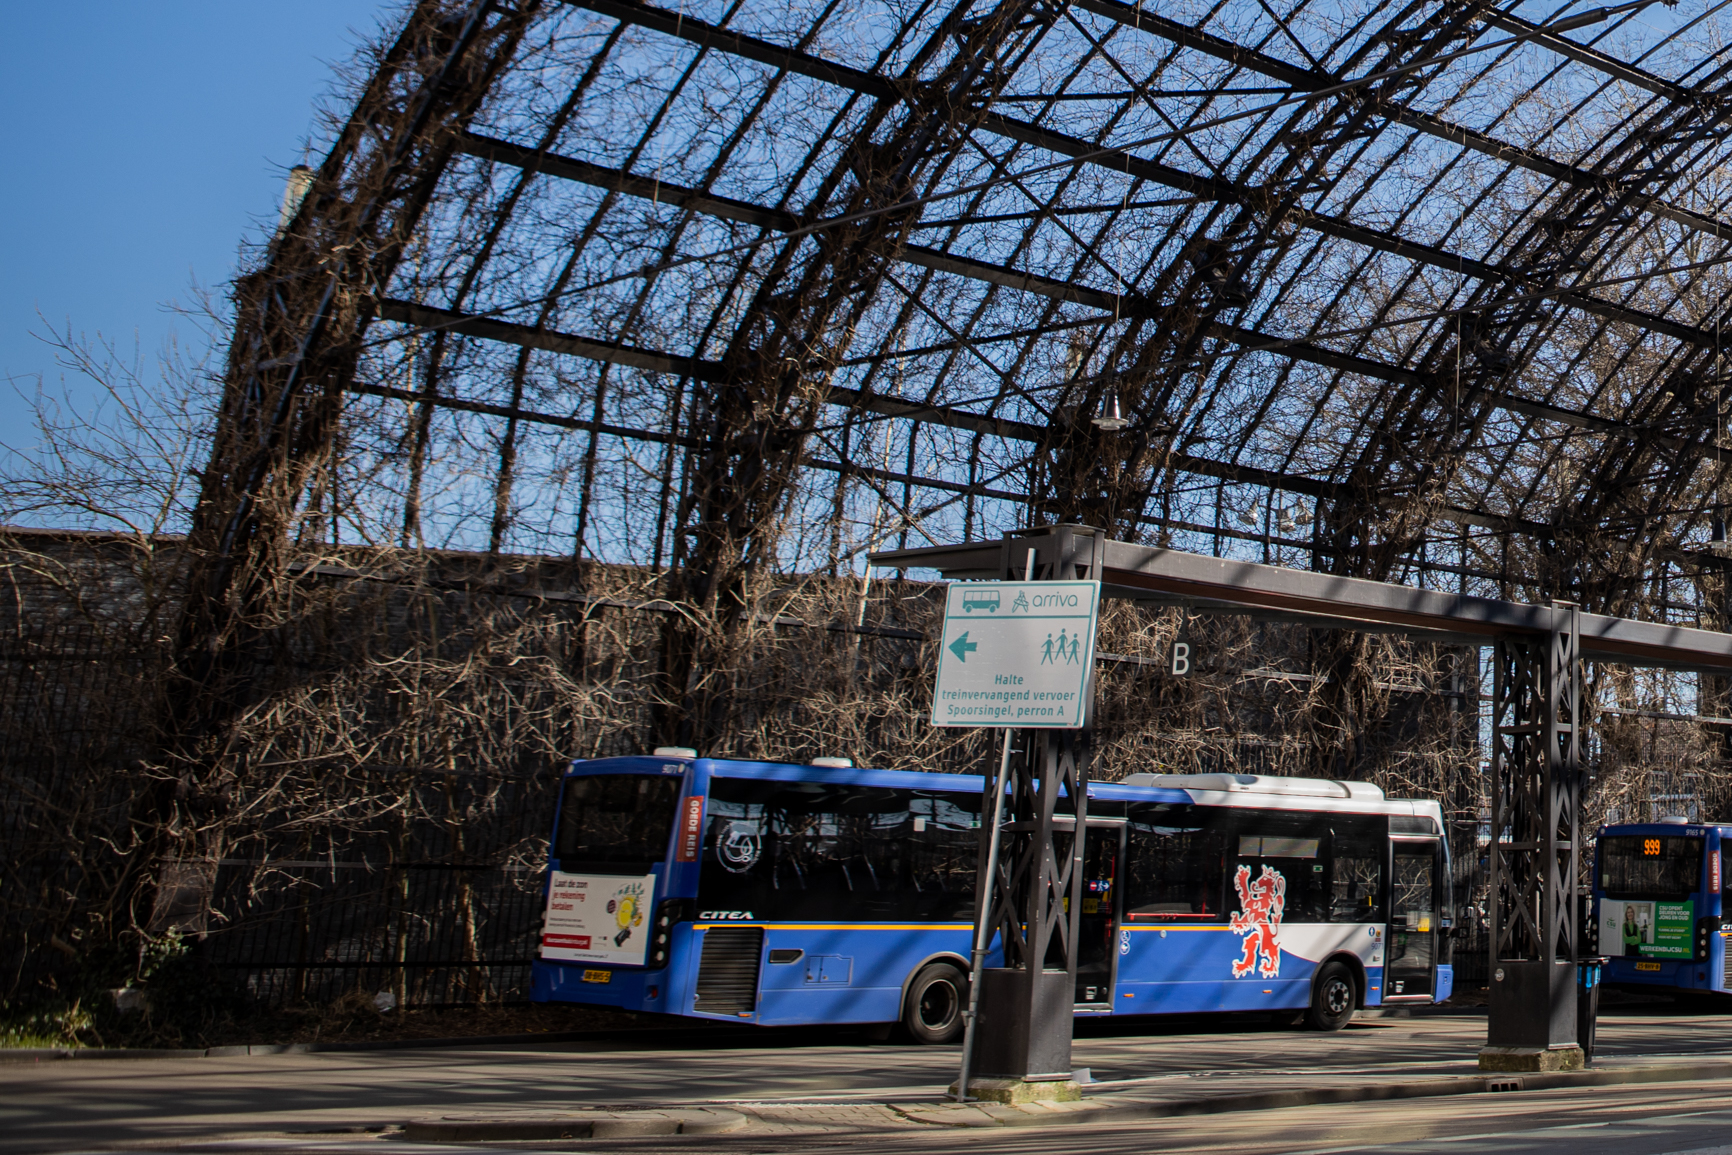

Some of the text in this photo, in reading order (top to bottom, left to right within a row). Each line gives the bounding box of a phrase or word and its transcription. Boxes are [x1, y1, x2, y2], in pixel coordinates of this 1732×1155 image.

[1032, 591, 1078, 608] arriva
[1172, 642, 1190, 676] B
[994, 674, 1024, 686] Halte
[942, 690, 1075, 703] treinvervangend vervoer
[947, 704, 1064, 718] Spoorsingel, perron A
[686, 799, 700, 858] GOEDE REIS
[1686, 828, 1699, 836] 9165
[1644, 839, 1660, 856] 999
[554, 878, 568, 888] Laat
[568, 880, 576, 888] de
[699, 910, 754, 920] CITEA
[1606, 920, 1616, 928] CSU
[1371, 942, 1384, 950] 9071
